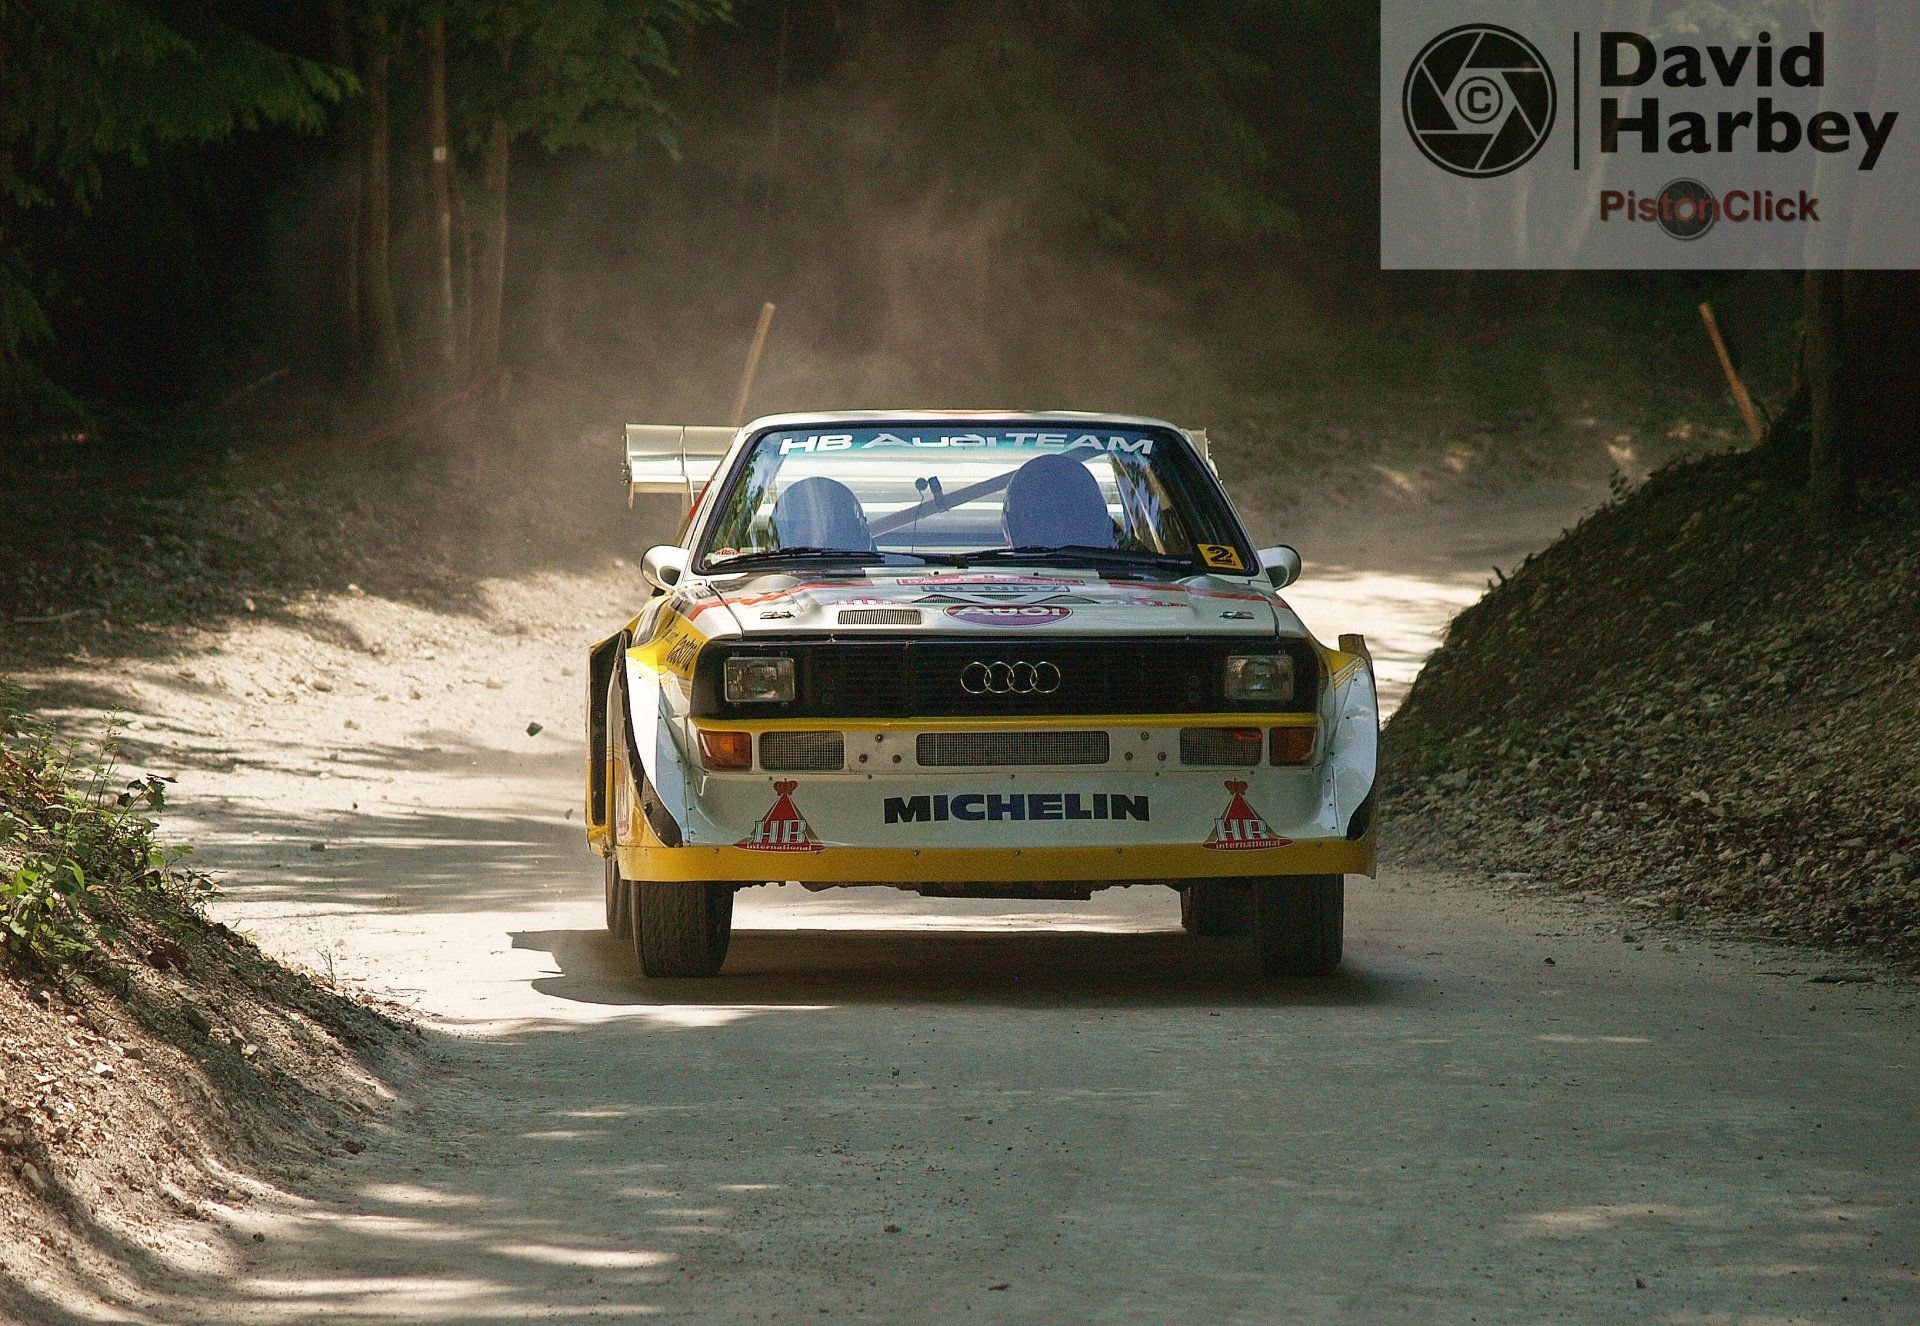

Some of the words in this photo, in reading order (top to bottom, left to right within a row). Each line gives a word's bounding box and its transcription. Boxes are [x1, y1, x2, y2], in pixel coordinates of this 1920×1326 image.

[779, 434, 853, 455] HB
[1005, 432, 1156, 455] TEAM
[1207, 545, 1235, 566] 2
[883, 793, 1150, 824] MICHELIN
[752, 820, 808, 844] HB
[1216, 839, 1281, 849] international
